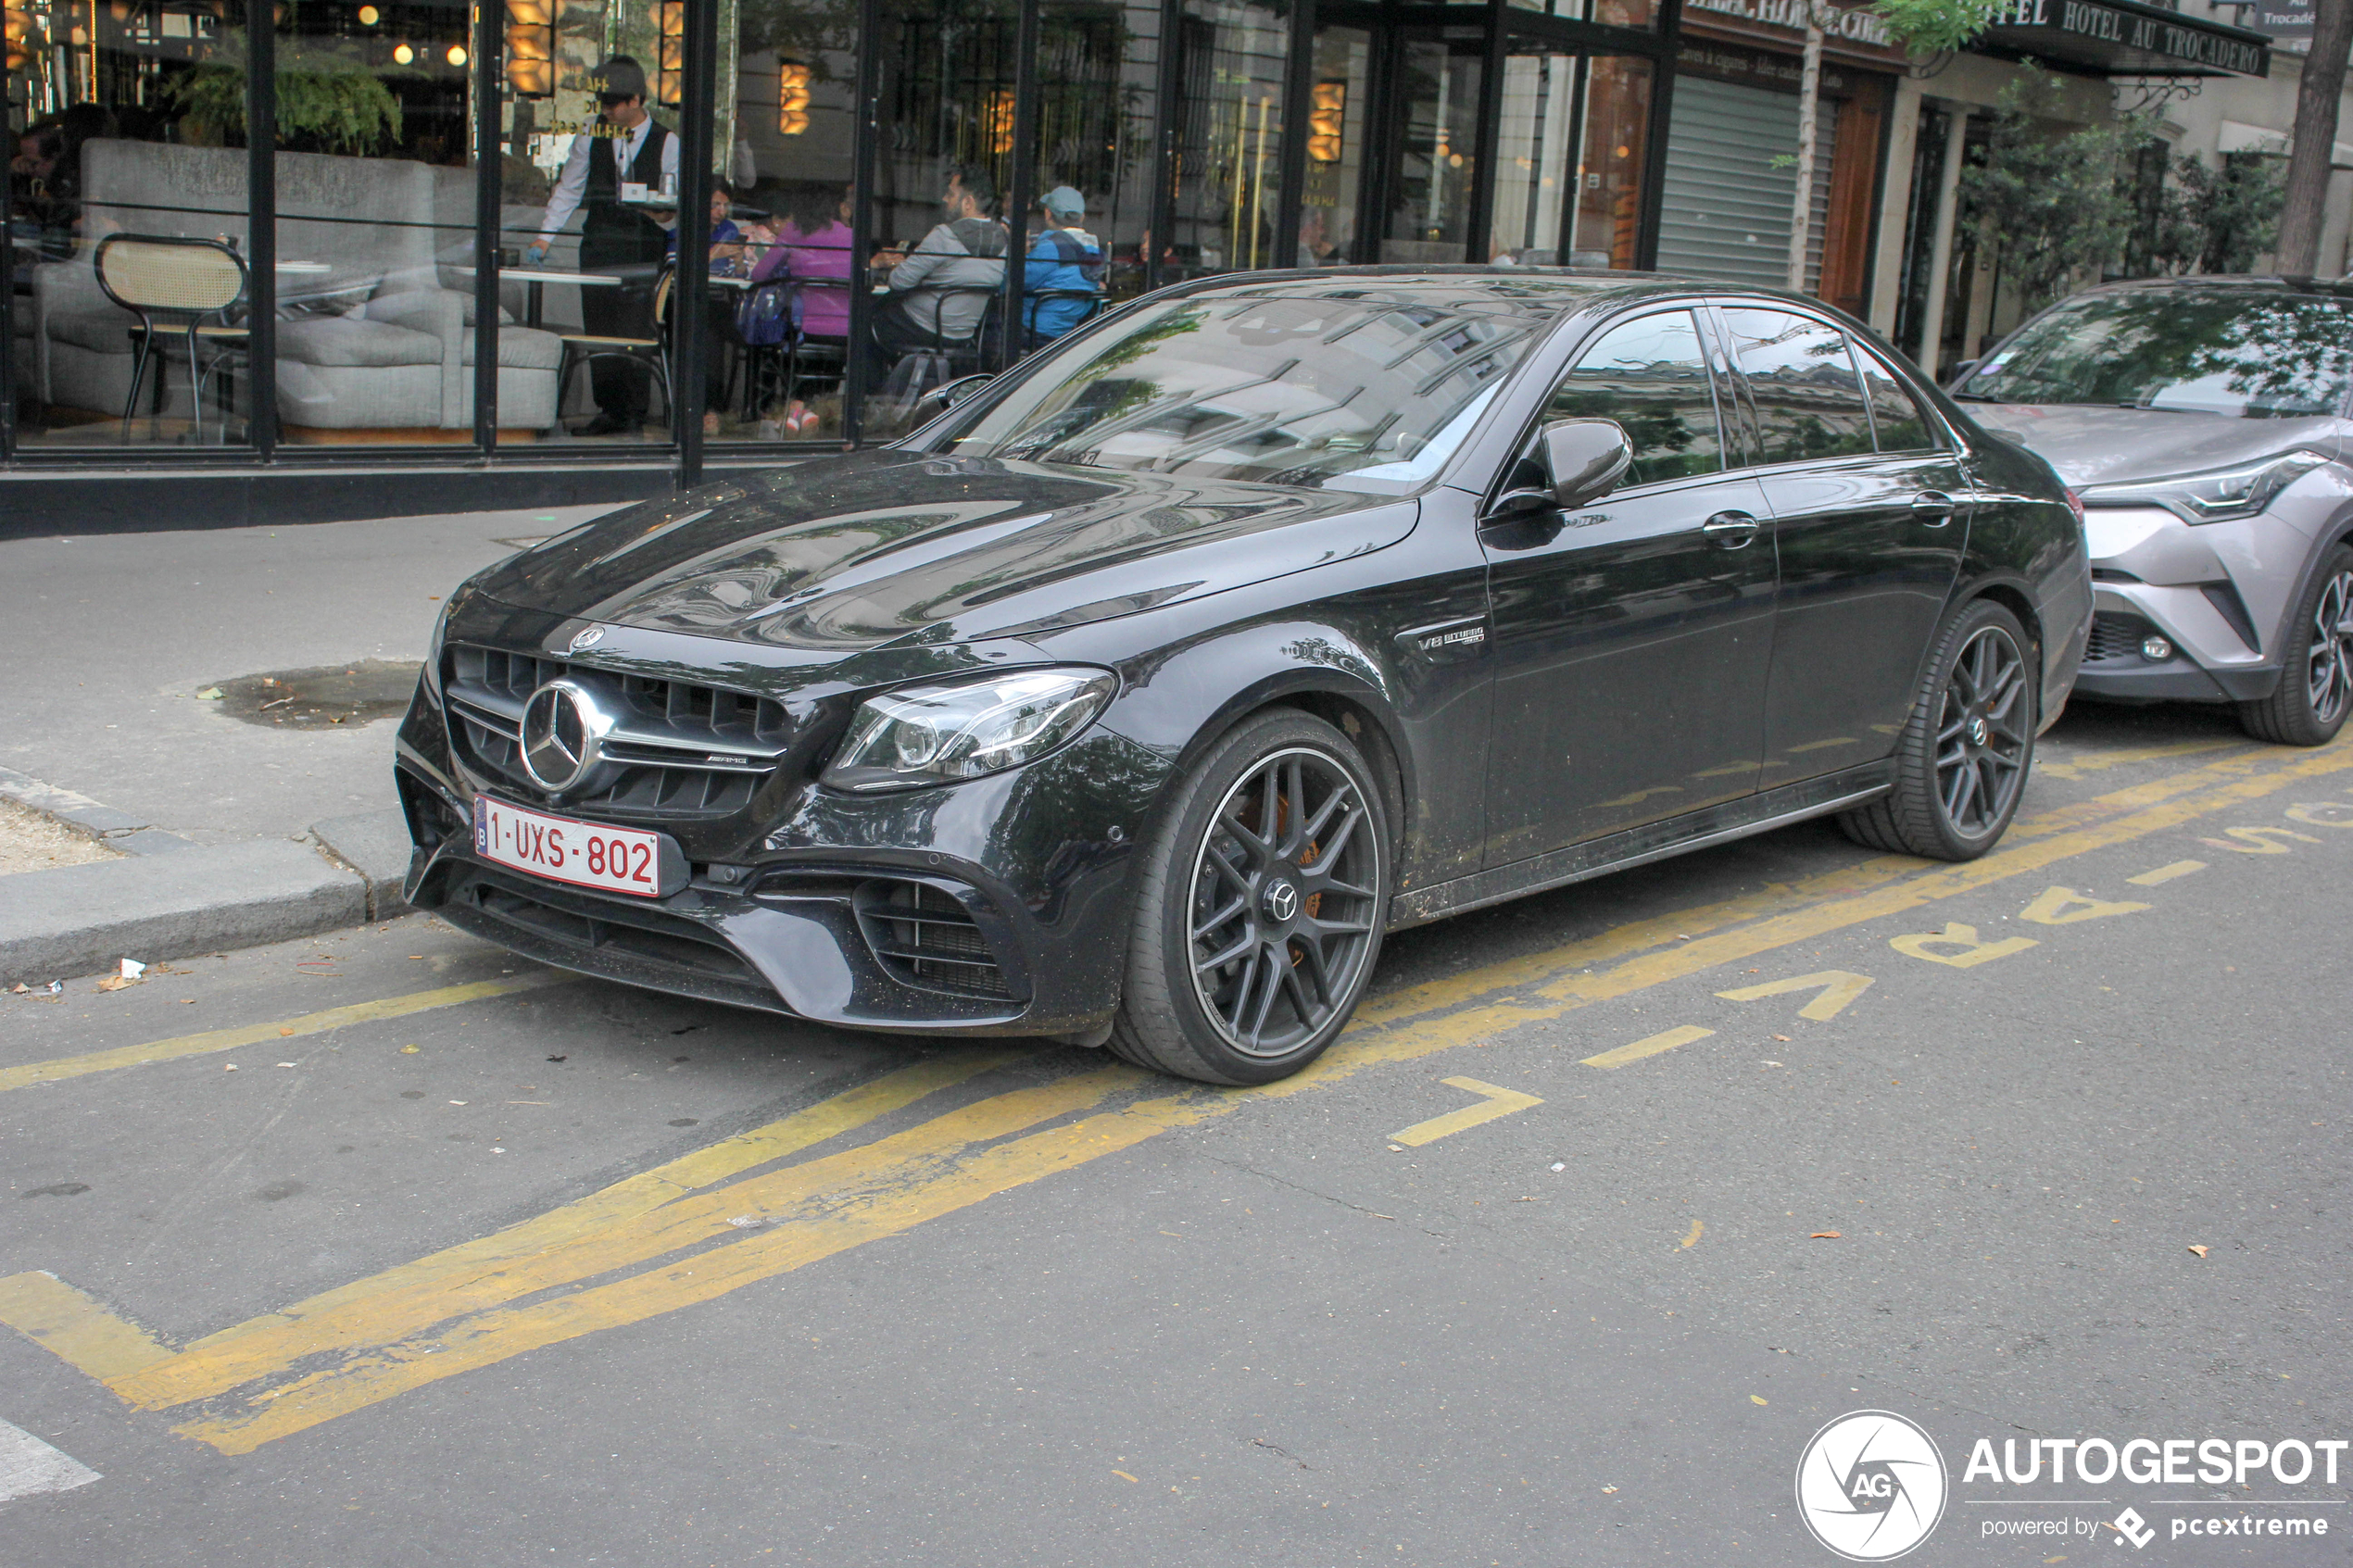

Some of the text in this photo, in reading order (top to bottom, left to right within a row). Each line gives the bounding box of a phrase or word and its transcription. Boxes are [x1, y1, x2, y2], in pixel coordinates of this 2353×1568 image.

[2062, 1, 2259, 74] HOTEL AU TROCADERO
[2264, 11, 2316, 24] Trocadé
[1417, 635, 1442, 651] V8
[1444, 627, 1484, 642] BITURBO
[478, 827, 486, 847] B
[490, 811, 652, 884] 1-UXS-802
[1389, 787, 2353, 1148] LIVRAISO
